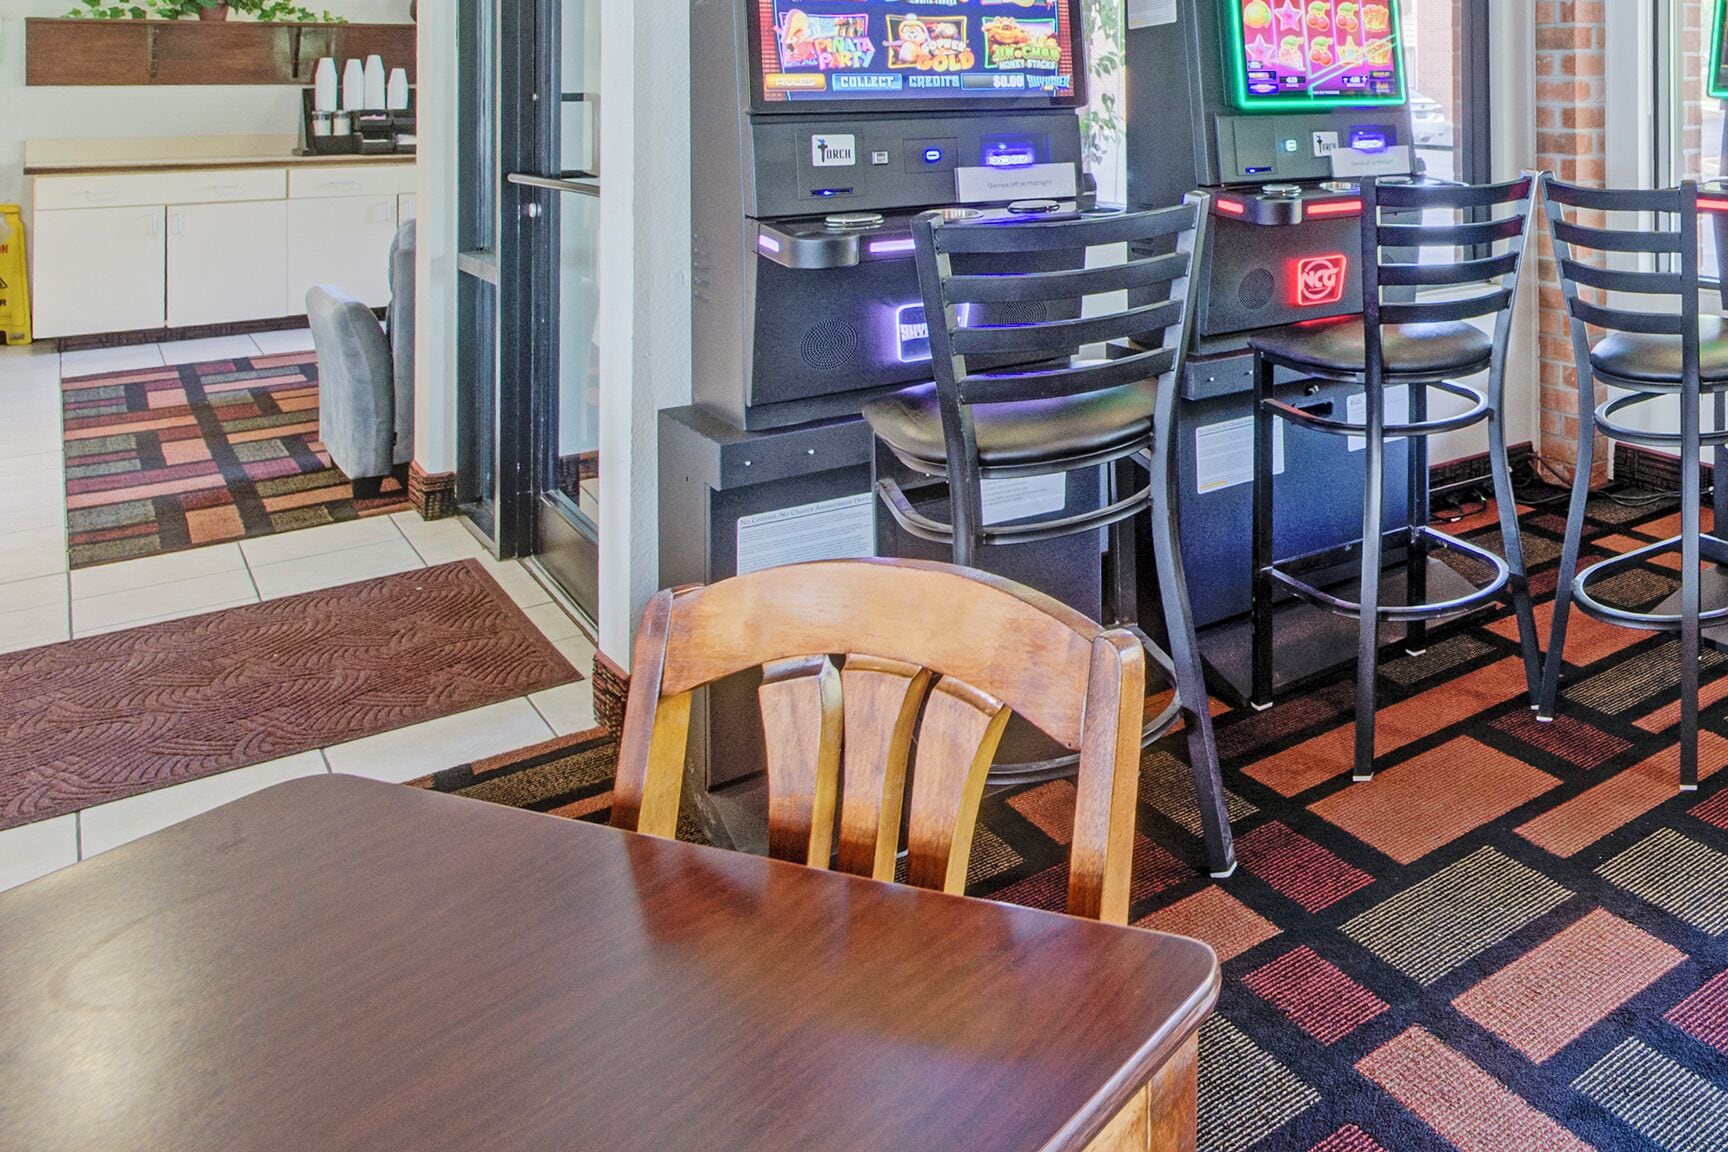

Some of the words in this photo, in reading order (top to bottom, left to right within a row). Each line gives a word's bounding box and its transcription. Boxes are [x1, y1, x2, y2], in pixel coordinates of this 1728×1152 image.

[816, 50, 875, 71] PARTY
[915, 51, 975, 72] GOLD
[775, 78, 816, 87] RULES
[840, 76, 894, 88] COLLECT
[908, 75, 960, 88] CREDITS
[992, 74, 1024, 88] $0.00
[1300, 267, 1340, 288] NCG
